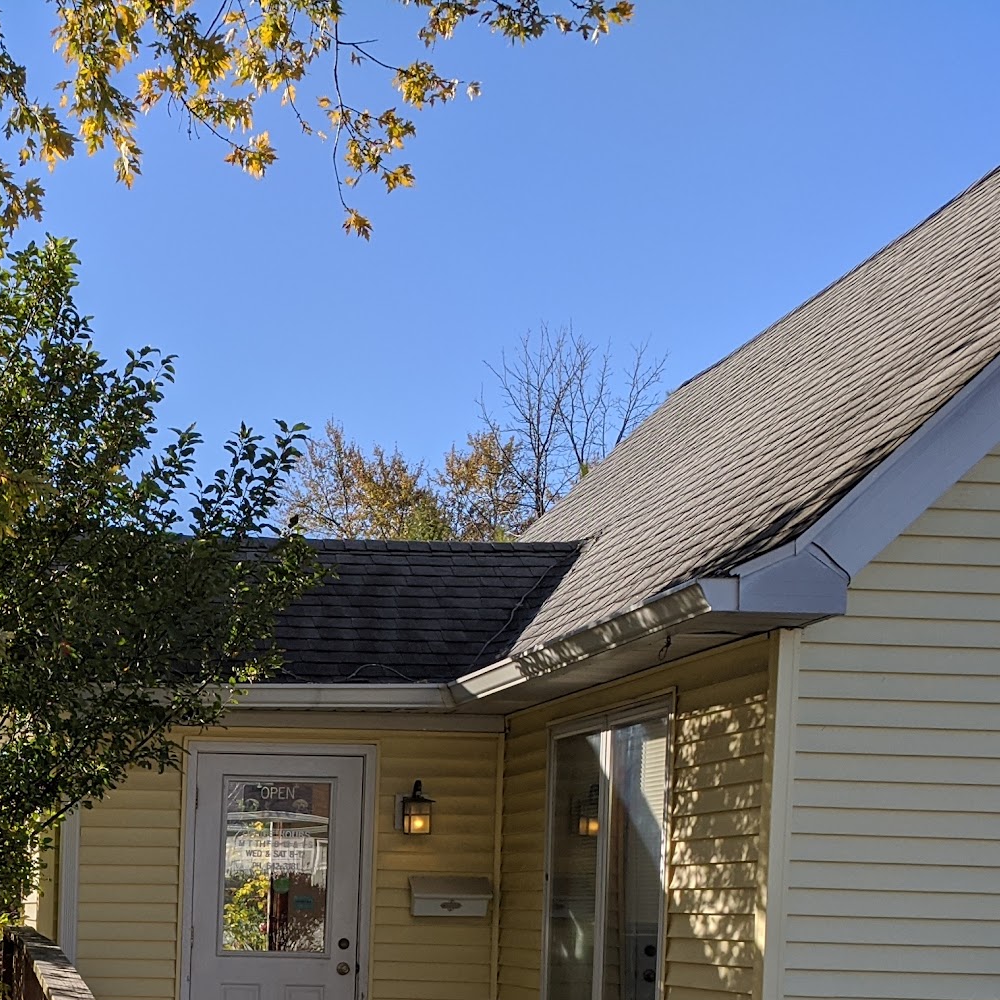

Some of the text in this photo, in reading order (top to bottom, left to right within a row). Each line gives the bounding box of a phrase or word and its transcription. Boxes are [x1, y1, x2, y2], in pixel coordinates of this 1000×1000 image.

[260, 786, 295, 800] OPEN
[245, 849, 262, 858] WED
[265, 850, 271, 858] &
[273, 850, 287, 858] SAT
